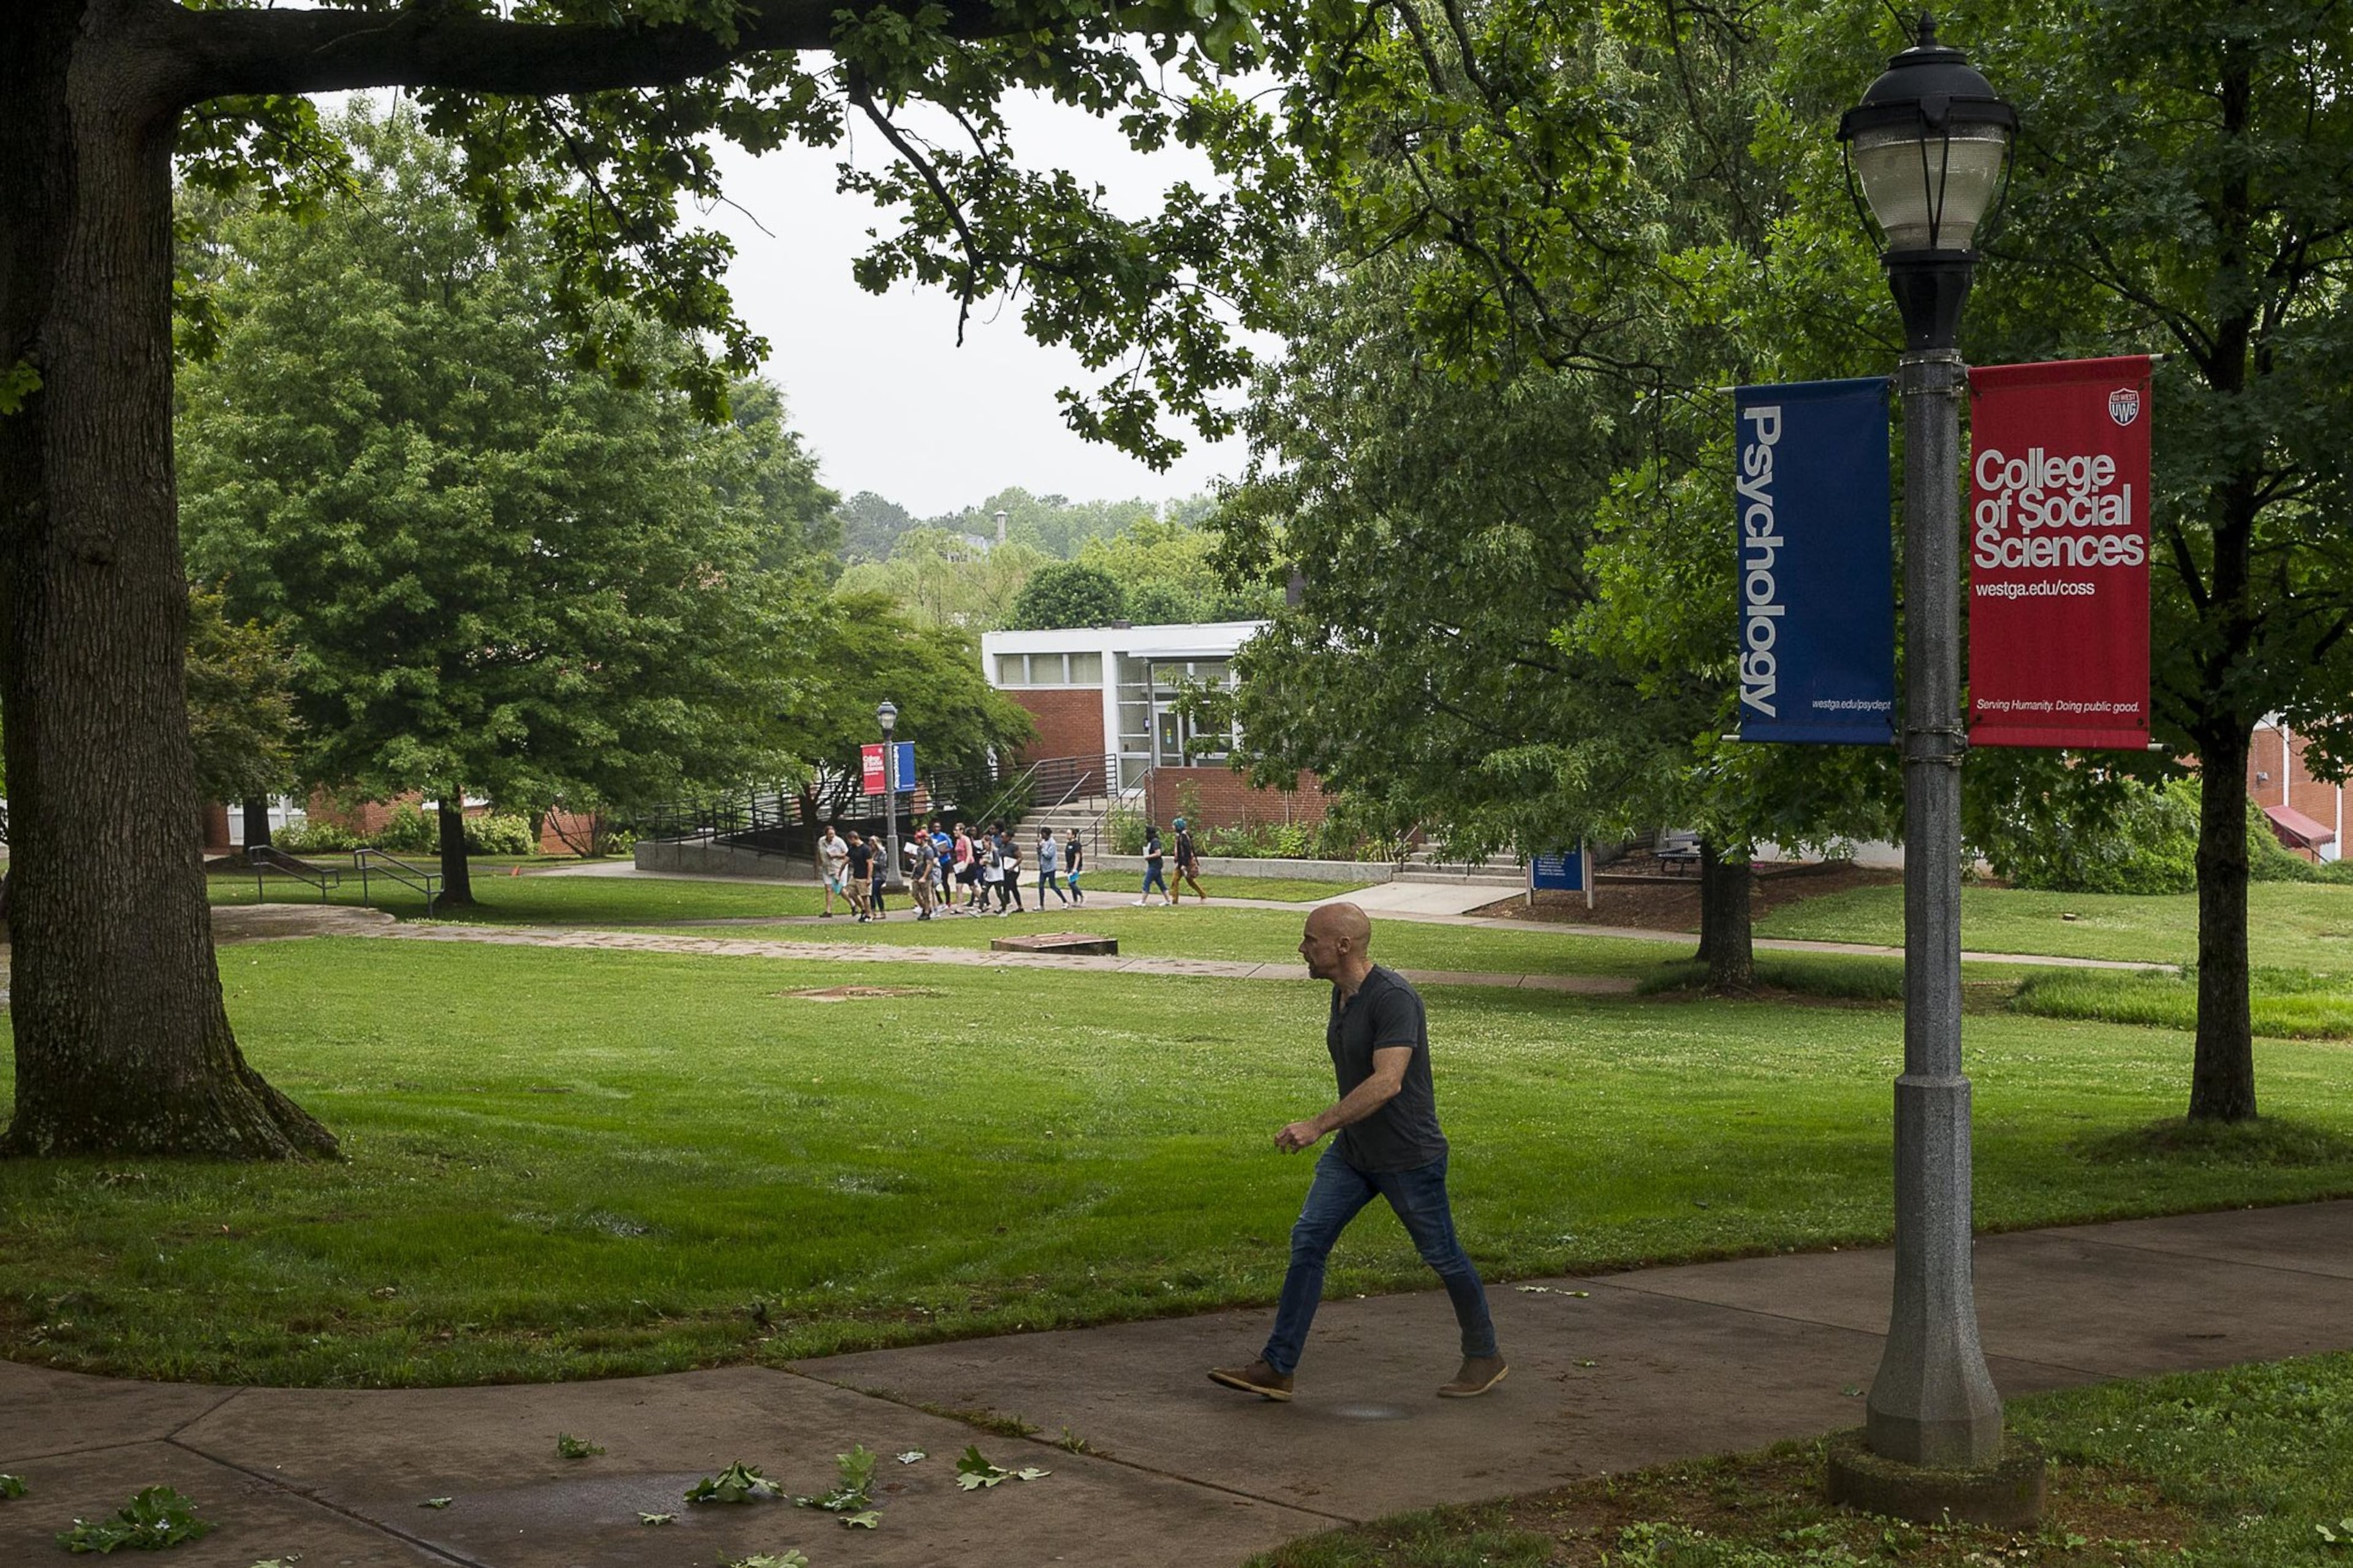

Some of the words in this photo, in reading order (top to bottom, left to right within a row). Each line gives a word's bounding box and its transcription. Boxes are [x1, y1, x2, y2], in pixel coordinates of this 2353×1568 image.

[2112, 403, 2137, 422] UWG
[1976, 447, 2116, 496] College
[1975, 489, 2012, 529] of
[2017, 483, 2131, 529] Social
[1736, 406, 1785, 718] Psychology
[1974, 527, 2145, 569] Sciences
[1976, 580, 2095, 599] westga.edu/coss
[1812, 699, 1891, 711] westga.edu/psydept
[1977, 699, 2010, 712] Serving
[2011, 700, 2054, 713] Humanity.
[2056, 700, 2082, 713] Doing
[2083, 700, 2112, 713] public
[2112, 701, 2140, 714] good.
